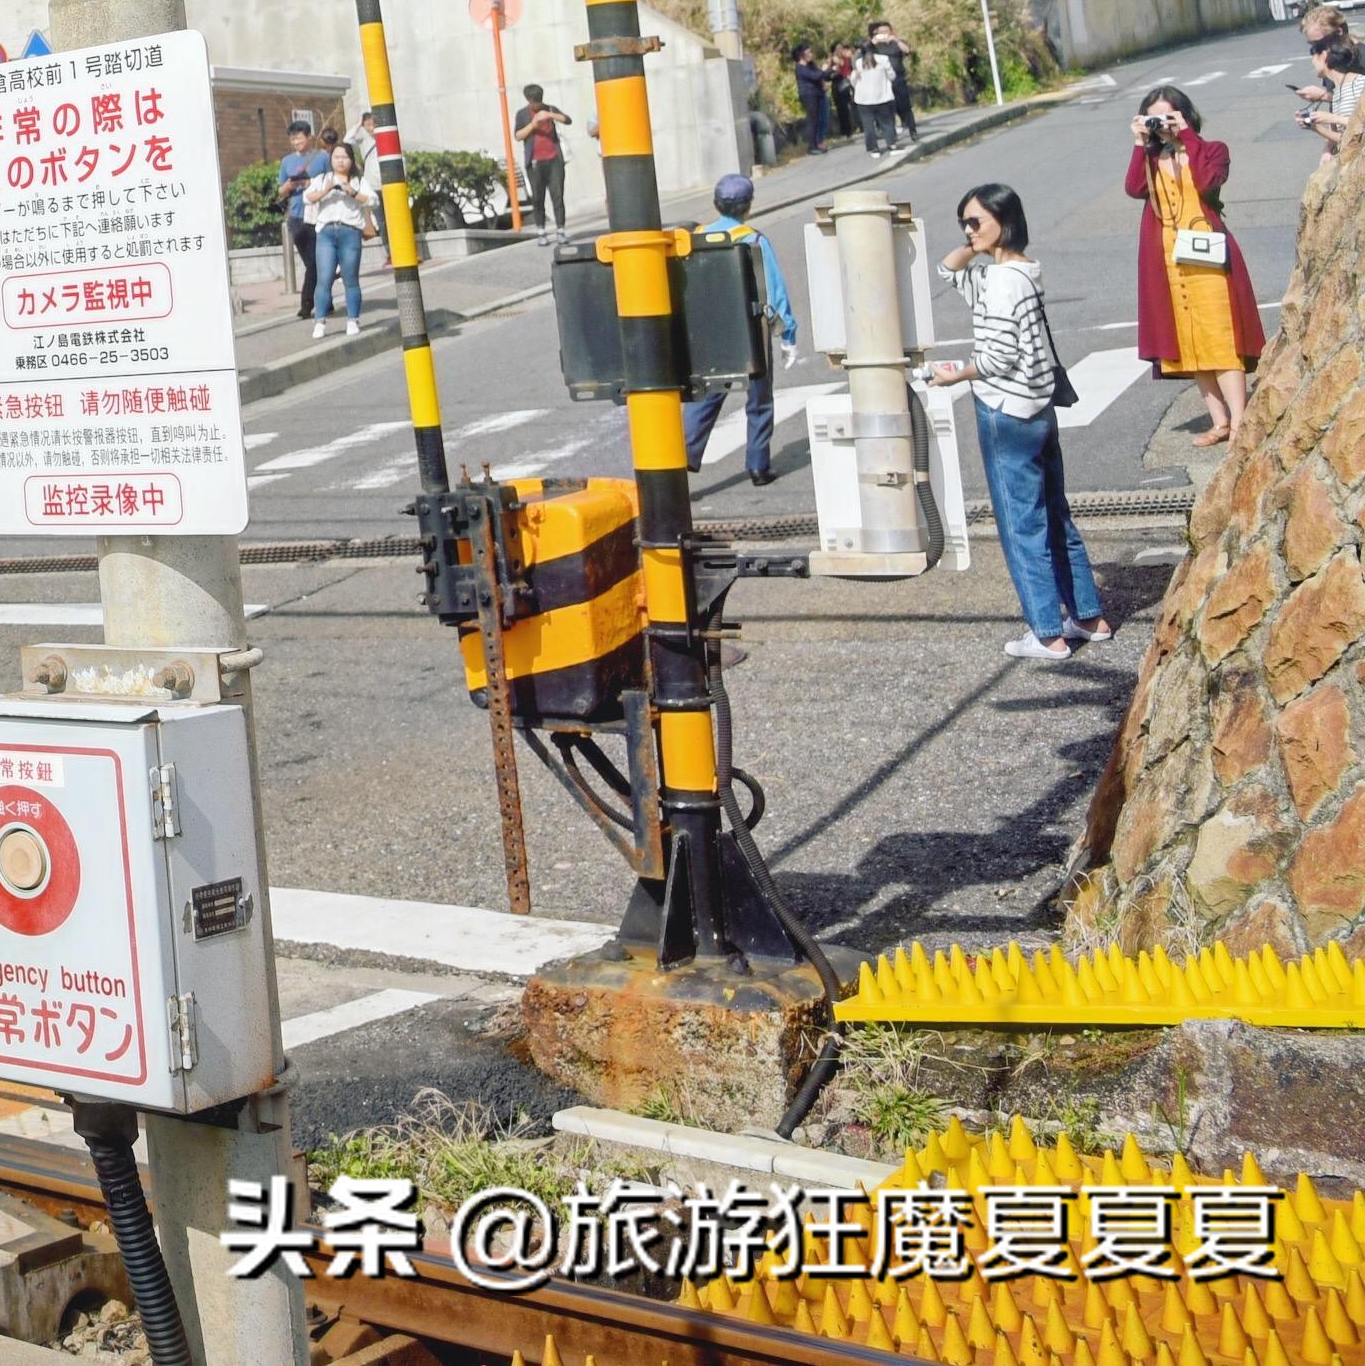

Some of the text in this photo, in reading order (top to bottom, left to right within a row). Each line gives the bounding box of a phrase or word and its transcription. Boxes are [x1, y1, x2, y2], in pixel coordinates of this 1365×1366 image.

[17, 276, 153, 316] カメラ監視中
[33, 327, 146, 350] 江ノ島電鉄株式会社
[15, 347, 169, 371] 乗務区 0466-25-3503
[80, 384, 212, 417] 请勿随便触碰
[42, 482, 165, 517] 监控录像中
[61, 966, 127, 998] button
